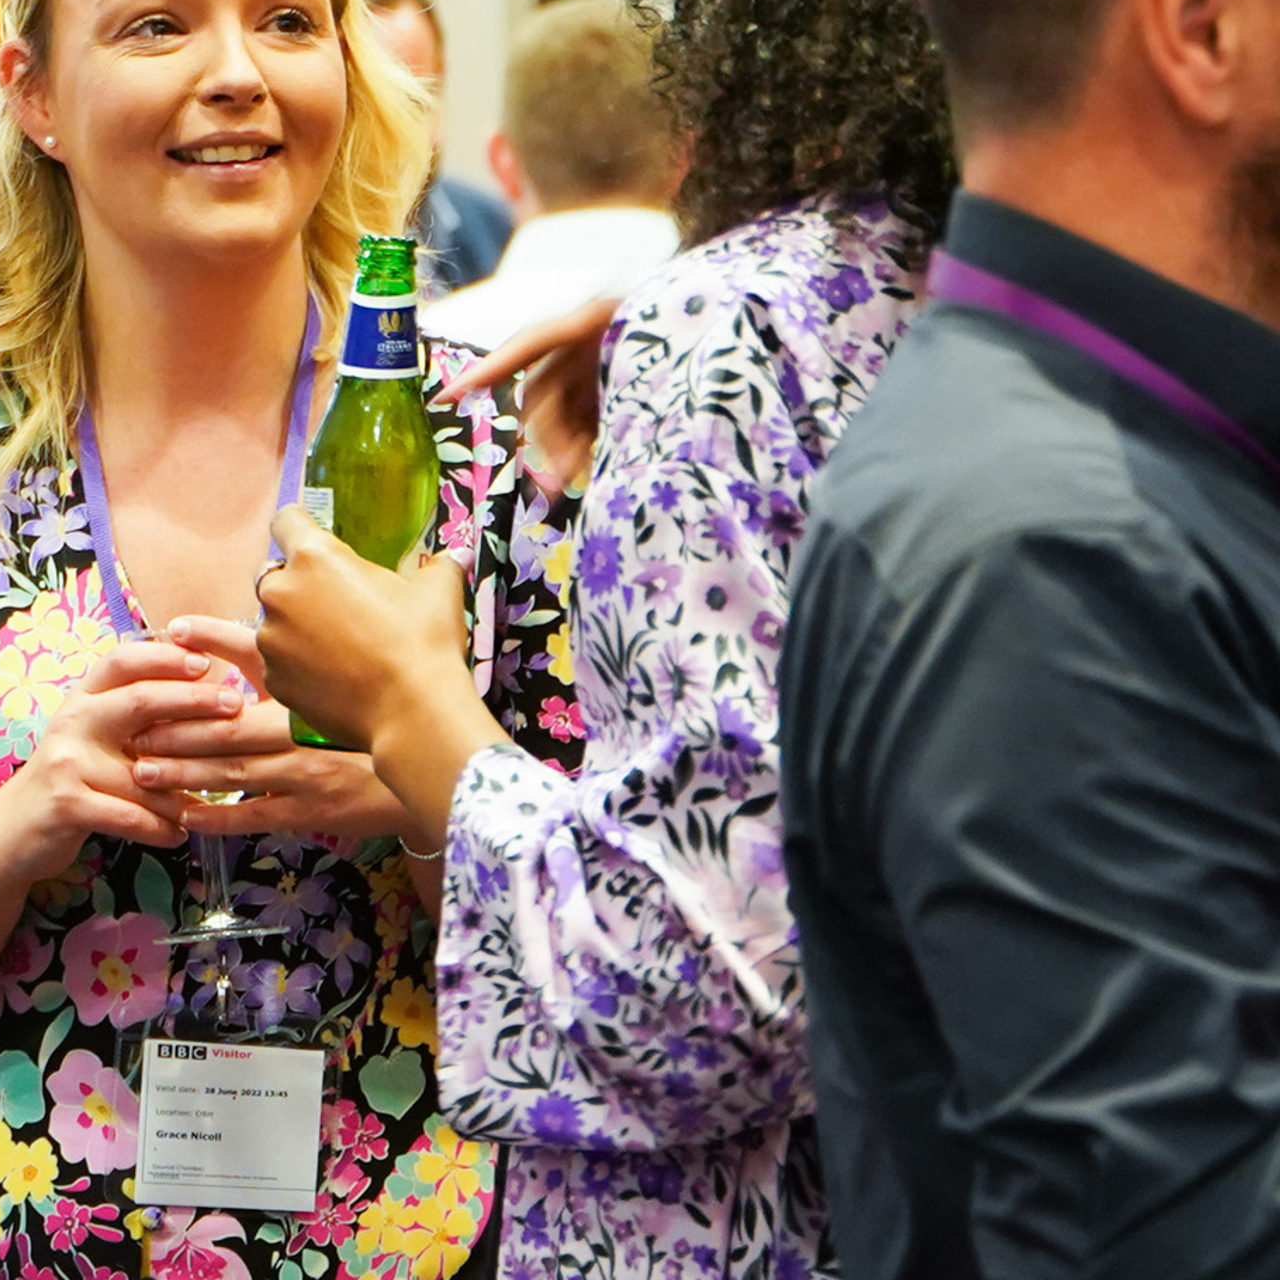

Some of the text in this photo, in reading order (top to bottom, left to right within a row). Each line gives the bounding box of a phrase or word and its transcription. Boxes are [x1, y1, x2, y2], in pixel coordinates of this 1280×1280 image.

[158, 1044, 253, 1060] BBC Visitor
[156, 1130, 222, 1141] Grace Nicoll
